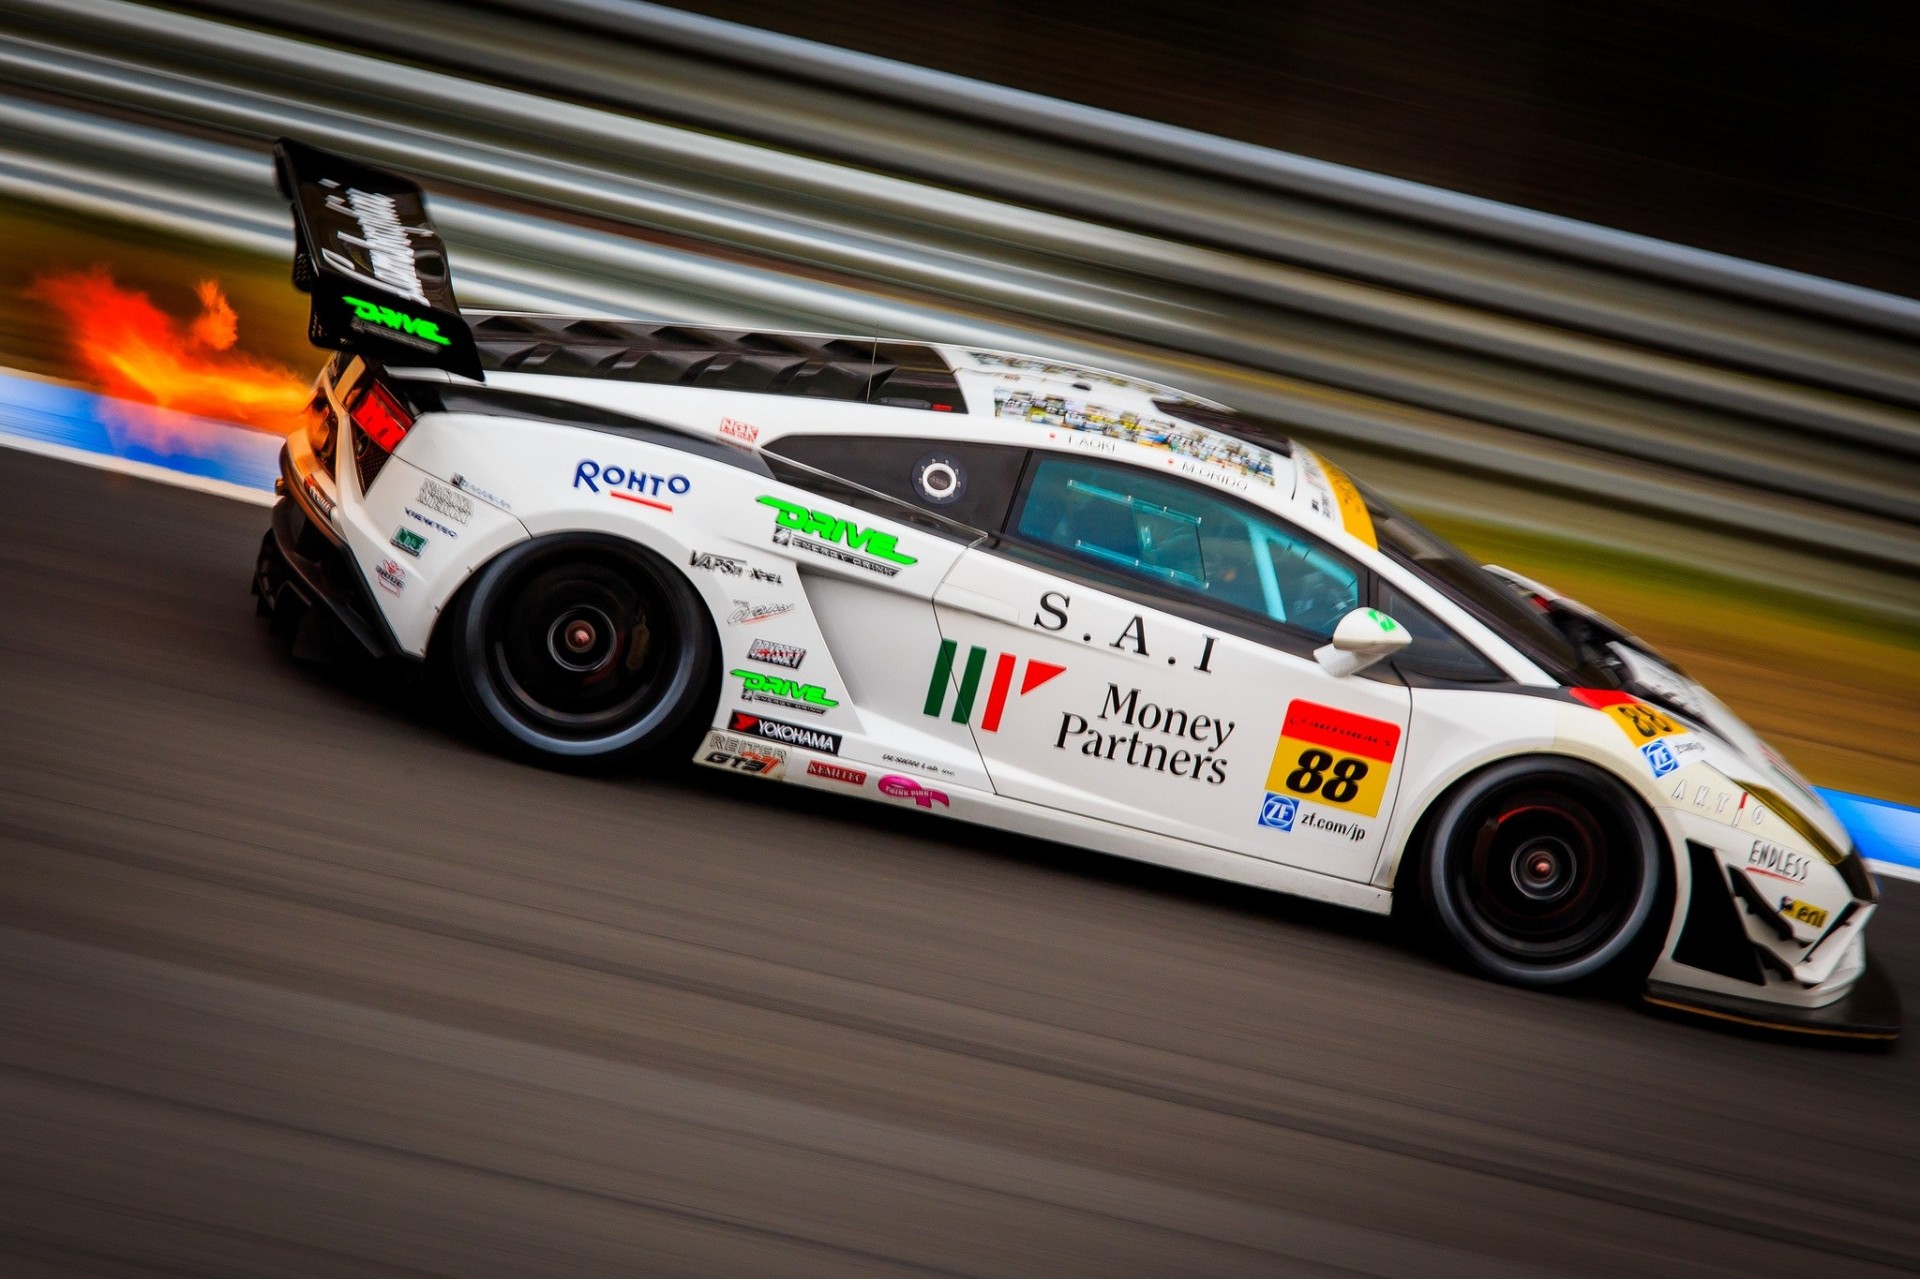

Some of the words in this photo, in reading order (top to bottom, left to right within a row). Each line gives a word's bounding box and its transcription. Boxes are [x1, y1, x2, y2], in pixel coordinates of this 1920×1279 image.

[342, 296, 452, 345] DRIVE
[721, 416, 758, 442] NGK
[573, 459, 691, 494] ROHTO
[754, 494, 918, 566] DRIVE
[792, 537, 850, 562] ENERGY
[851, 557, 898, 577] DRINK
[729, 668, 839, 708] DRIVE
[758, 718, 834, 753] YOKOHAMA
[1097, 682, 1236, 753] Money
[709, 733, 787, 766] REITER
[1053, 711, 1228, 785] Partners
[808, 762, 862, 785] KEMITEC
[1286, 748, 1369, 803] 88
[1300, 812, 1366, 841] zf.com/jp
[1747, 839, 1810, 882] ENDLESS
[1797, 905, 1828, 929] eni
